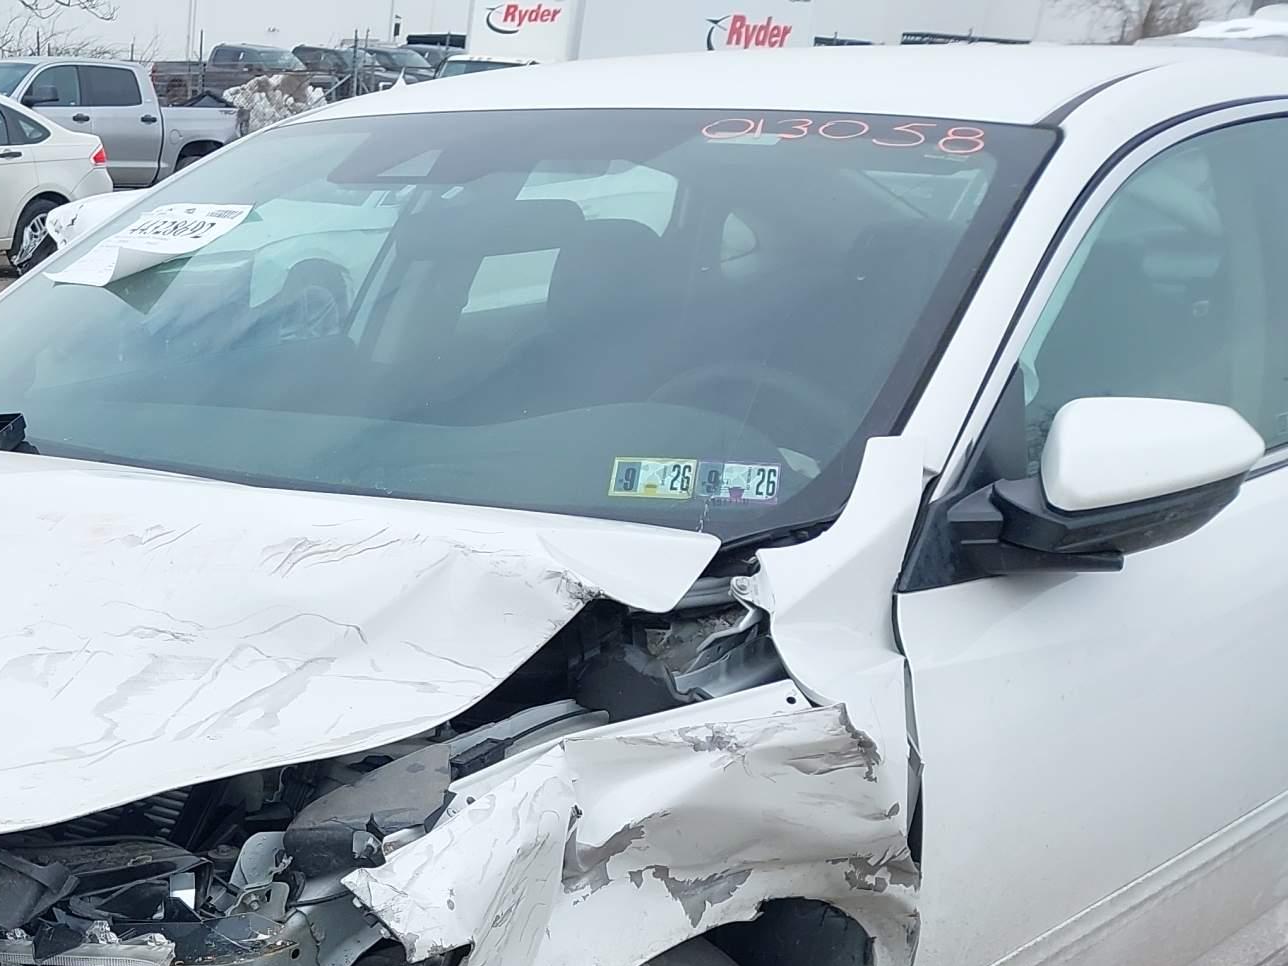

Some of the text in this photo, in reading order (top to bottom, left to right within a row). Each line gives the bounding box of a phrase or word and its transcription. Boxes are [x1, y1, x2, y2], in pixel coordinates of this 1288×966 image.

[503, 3, 562, 27] Ryder
[726, 14, 793, 49] Ryder
[623, 467, 637, 491] 9
[669, 463, 692, 492] 26
[755, 467, 777, 497] 26
